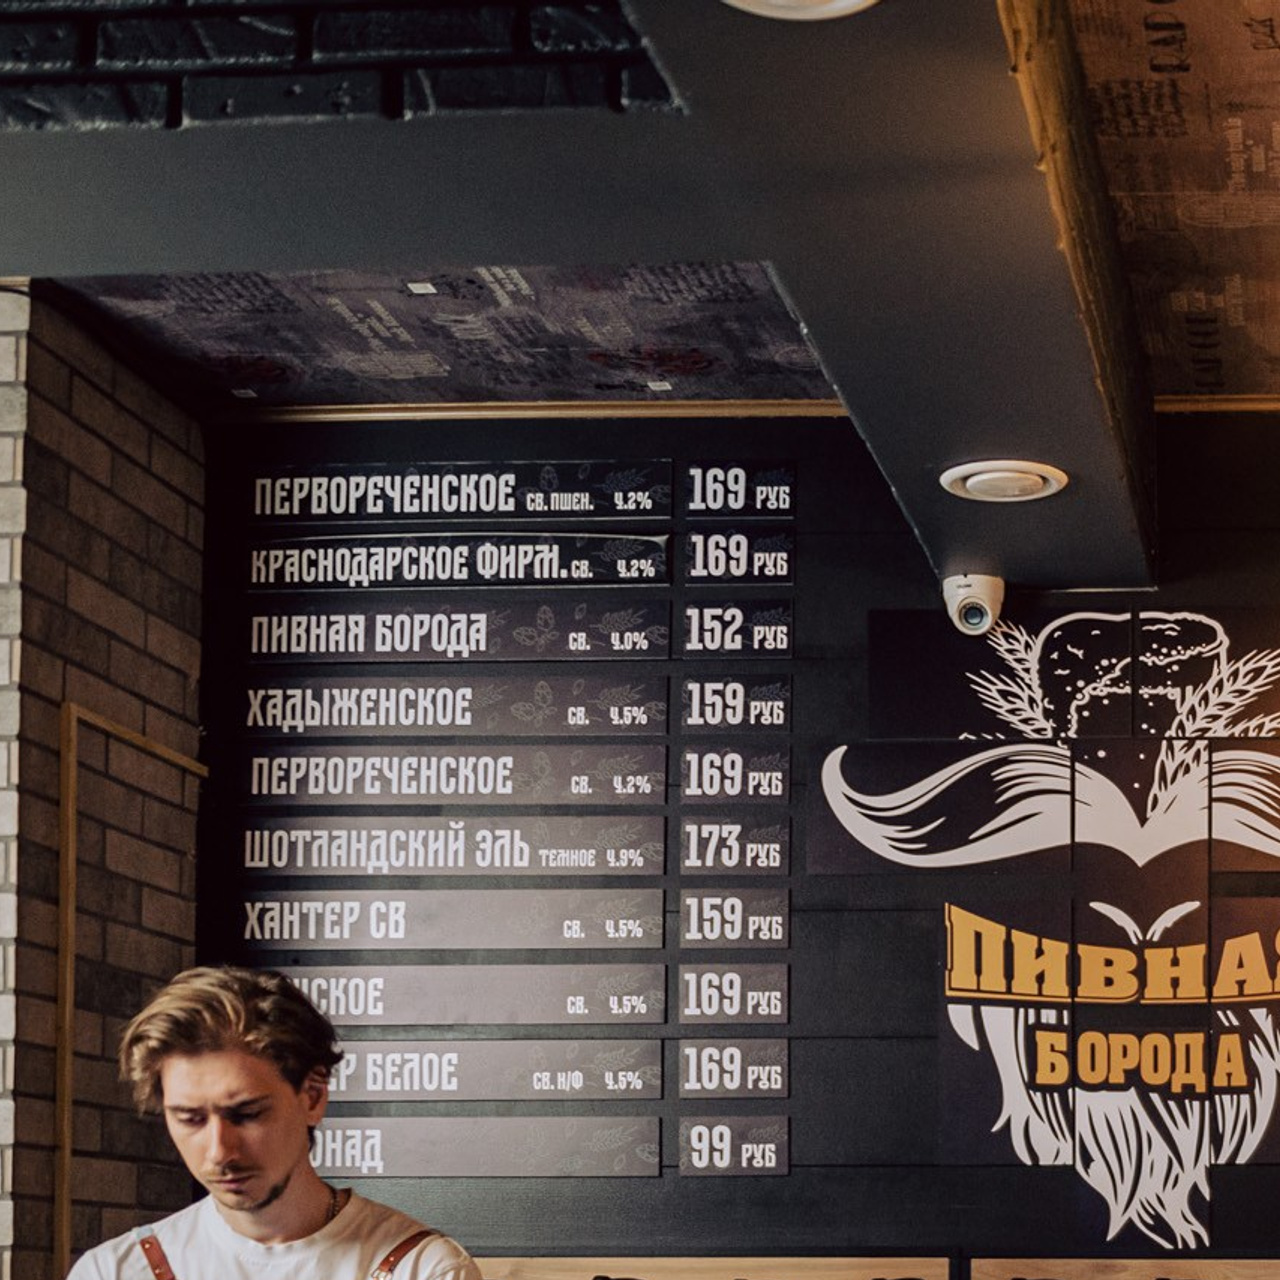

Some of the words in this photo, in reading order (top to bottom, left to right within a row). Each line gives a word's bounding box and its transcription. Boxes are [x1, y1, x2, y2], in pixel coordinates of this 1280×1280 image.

[255, 473, 516, 515] ПЕРВОРЕЧЕНСКОЕ
[614, 491, 652, 510] 4.2%
[688, 467, 746, 511] 169
[755, 489, 791, 510] РУБ
[251, 545, 469, 587] КРАСНОДАРСКОЕ
[476, 543, 568, 580] ФИРМ.
[571, 560, 593, 579] СВ.
[617, 560, 656, 578] 4.2%
[689, 534, 748, 578] 169
[754, 555, 789, 576] РУБ
[251, 614, 365, 653] ПИВНАЯ
[375, 613, 488, 658] БОРОДА
[568, 632, 591, 651] СВ.
[611, 631, 649, 651] 4.0%
[685, 607, 743, 651] 152
[754, 628, 788, 650] РУБ
[247, 688, 472, 733] ХАДЫЖЕНСКОЕ
[567, 707, 590, 725] СВ.
[686, 682, 744, 726] 159
[750, 702, 784, 725] РУБ
[251, 757, 513, 795] ПЕРВОРЕЧЕНСКОЕ
[571, 776, 593, 794] СВ.
[613, 775, 651, 794] 4.2%
[685, 753, 742, 796] 169
[748, 772, 783, 795] РУБ
[244, 821, 465, 874] ШОТЛАНДСКИЙ
[476, 830, 529, 866] ЭЛЬ
[539, 849, 596, 867] ТЕМНОЕ
[606, 848, 644, 867] 4.9%
[684, 824, 741, 867] 173
[746, 844, 781, 867] РУБ
[244, 901, 361, 941] ХАНТЕР
[370, 901, 407, 940] СВ
[563, 920, 585, 938] СВ.
[605, 920, 643, 938] 4.5%
[685, 898, 743, 941] 159
[748, 917, 783, 940] РУБ
[566, 996, 589, 1014] СВ.
[610, 995, 647, 1014] 4.5%
[683, 973, 741, 1016] 169
[747, 993, 782, 1015] РУБ
[367, 1052, 459, 1092] БЕЛОЕ
[605, 1071, 643, 1089] 4.5%
[683, 1047, 741, 1090] 169
[748, 1067, 782, 1089] РУБ
[1035, 1030, 1247, 1093] БОРОДА
[690, 1124, 731, 1168] 99
[741, 1145, 776, 1168] РУБ
